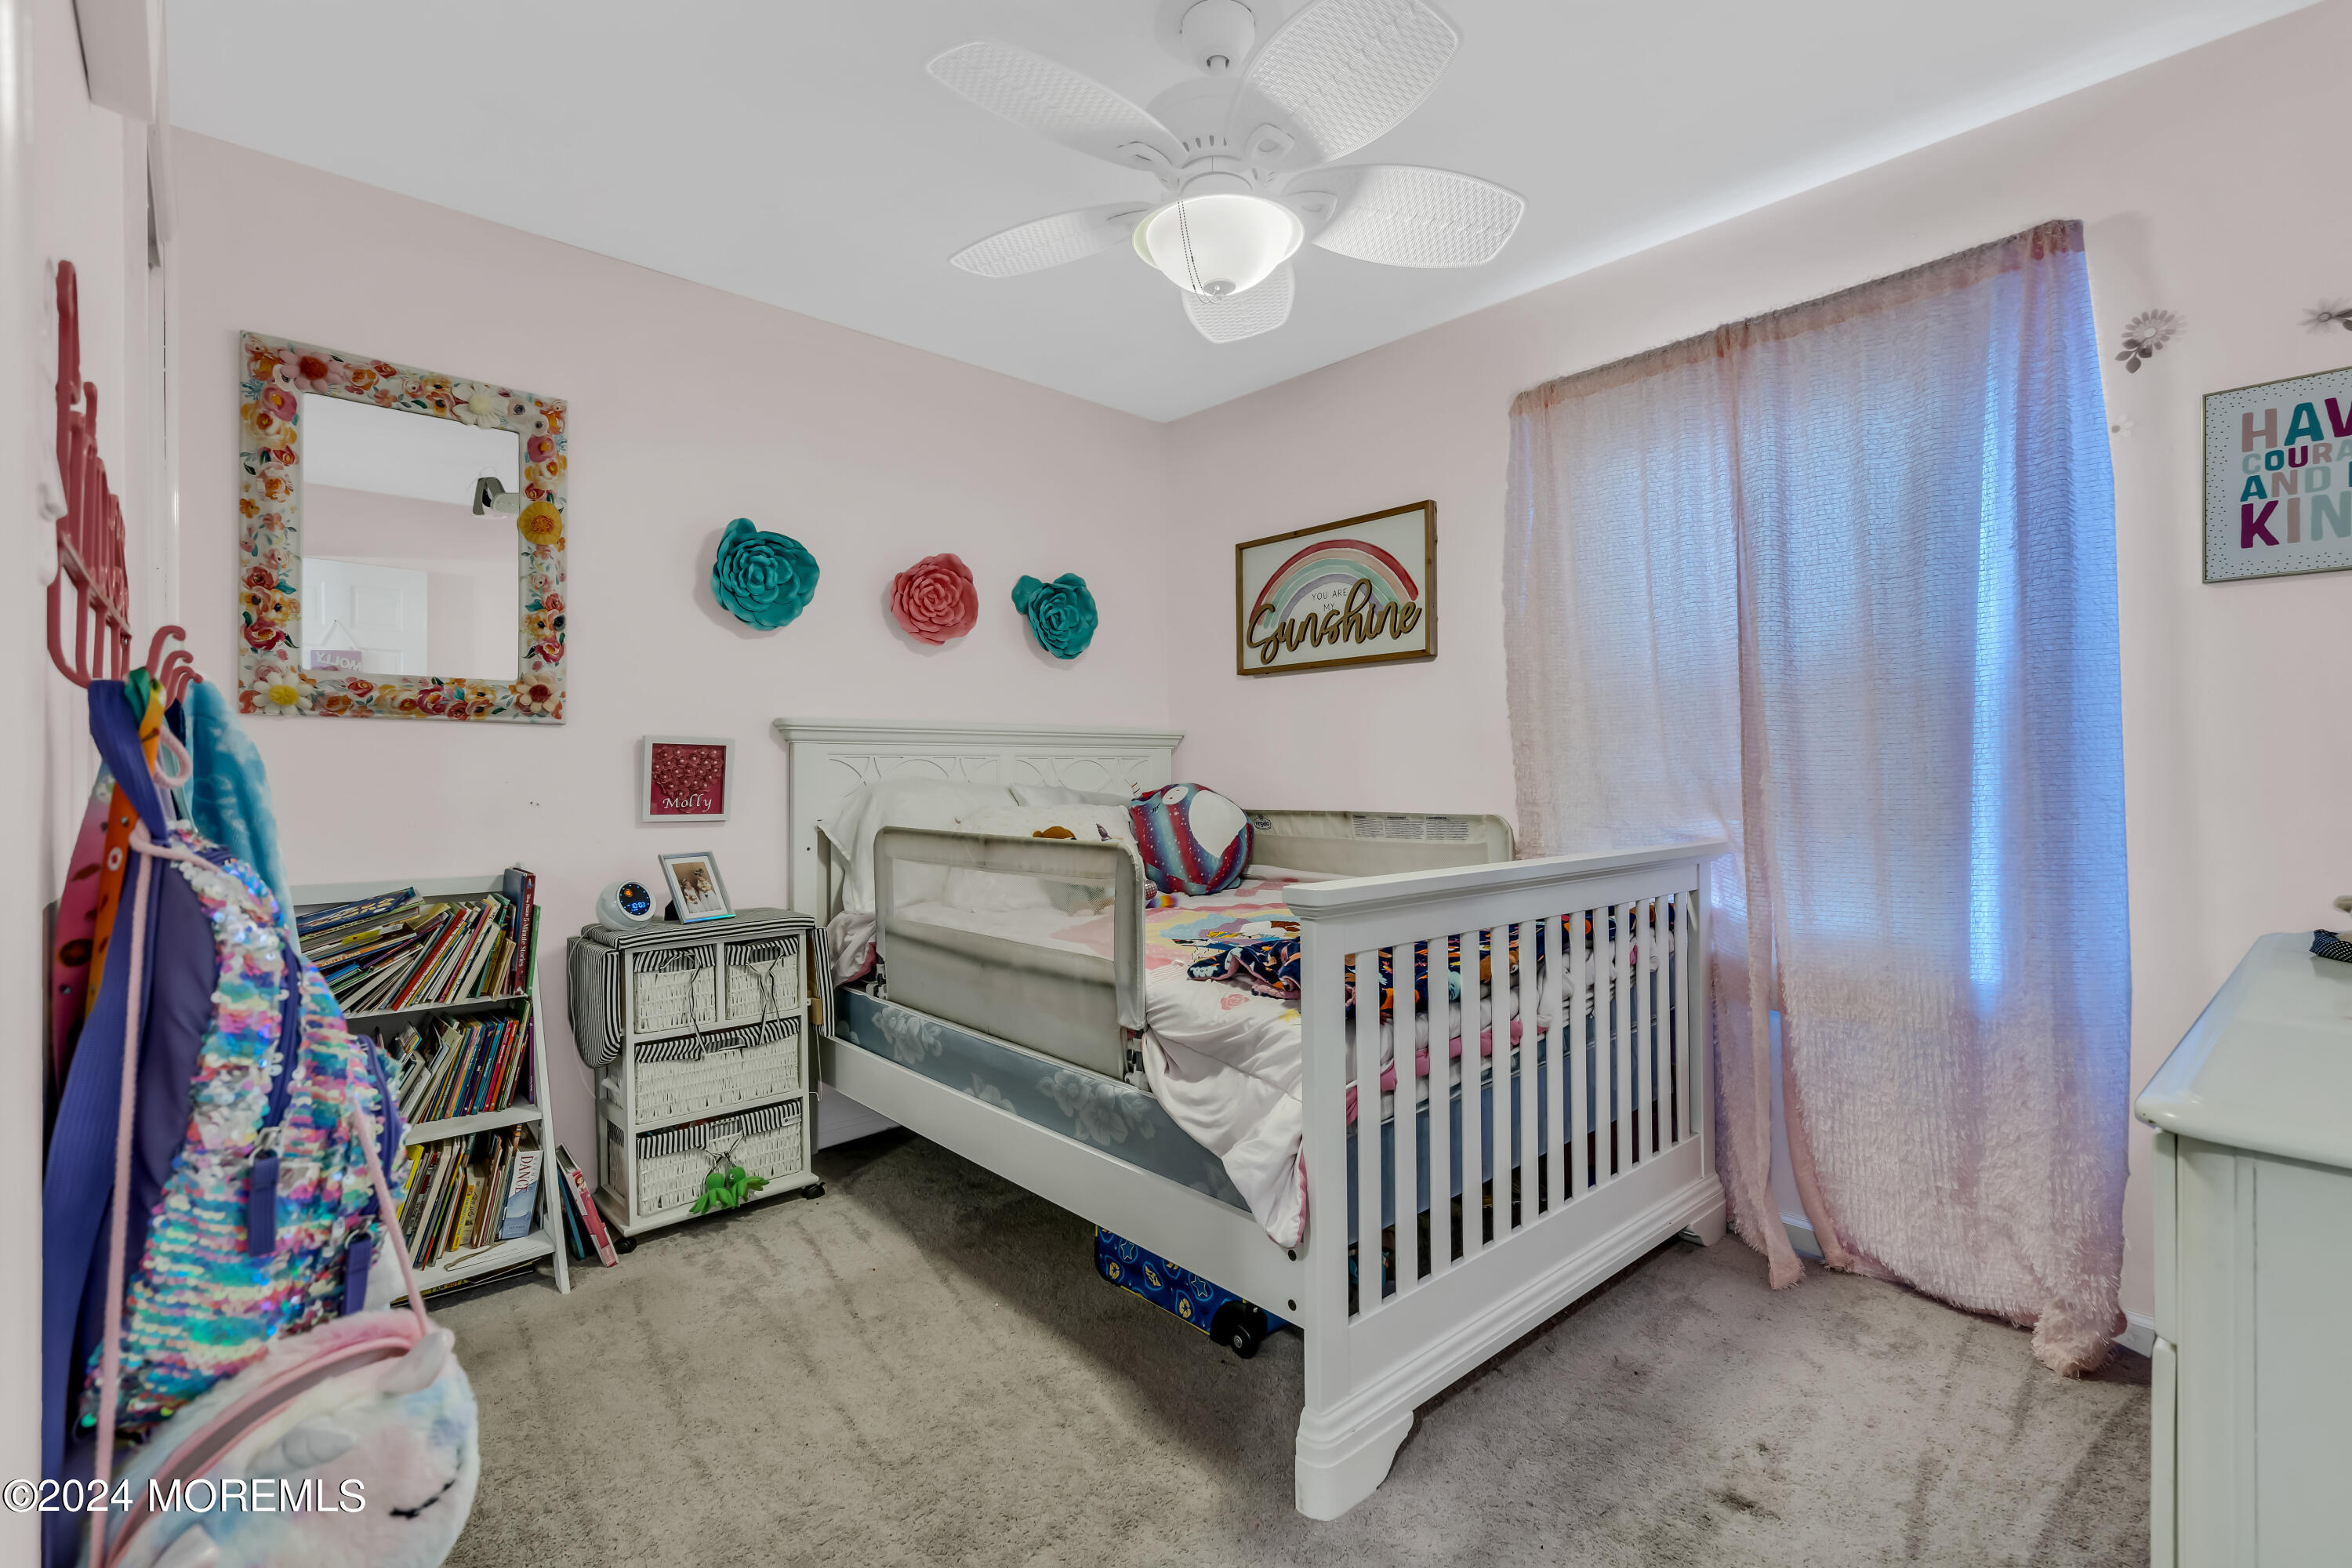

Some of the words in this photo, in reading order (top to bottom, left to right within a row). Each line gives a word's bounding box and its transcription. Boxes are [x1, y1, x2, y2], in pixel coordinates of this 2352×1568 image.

[2240, 466, 2331, 502] AND
[2240, 490, 2352, 549] KIN
[1312, 590, 1329, 601] YOU
[1332, 587, 1348, 597] ARE
[1323, 601, 1335, 612] MY
[1247, 578, 1422, 665] Sunshine
[662, 793, 712, 812] Molly
[521, 917, 530, 945] 5-Minute
[518, 946, 527, 967] Stories
[514, 1156, 534, 1194] DANCE
